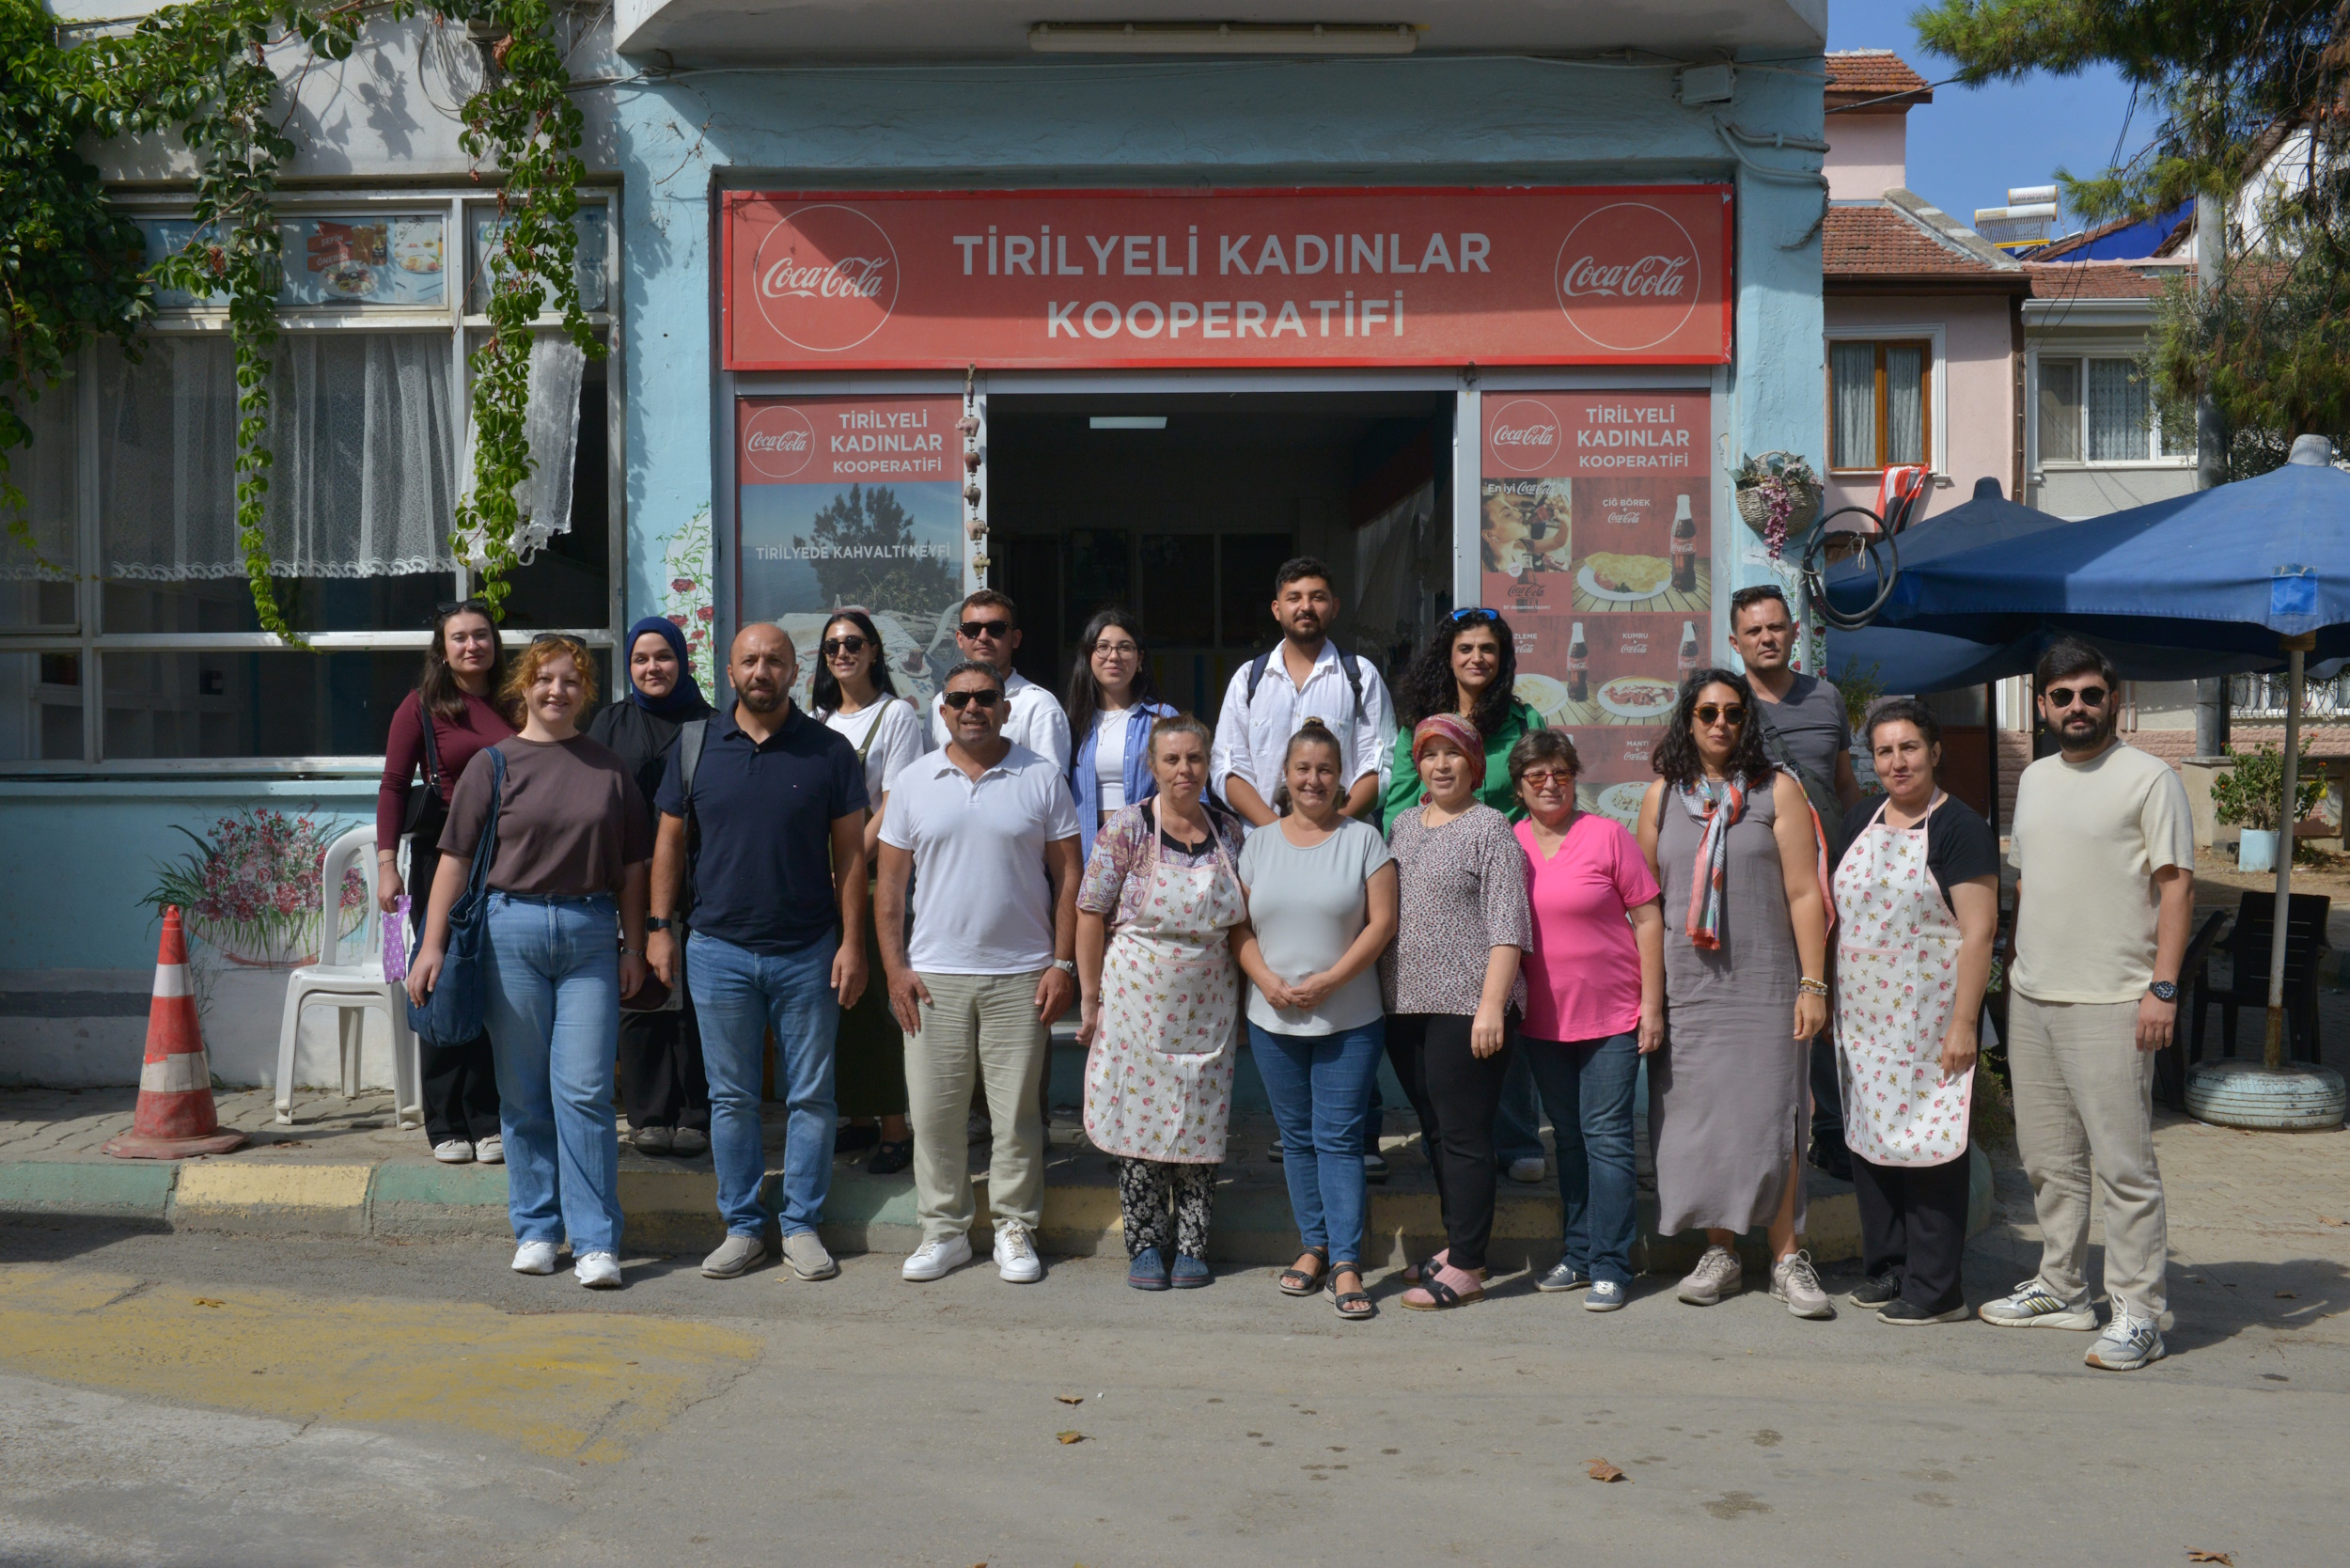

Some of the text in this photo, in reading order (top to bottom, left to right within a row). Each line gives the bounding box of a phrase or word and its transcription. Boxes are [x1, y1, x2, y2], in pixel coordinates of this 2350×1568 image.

[953, 225, 1490, 275] TİRİLYELİ KADINLAR
[761, 257, 889, 298] Coca-Cola
[1563, 255, 1691, 297] Coca-Cola
[1048, 290, 1403, 339] KOOPERATİFİ
[838, 409, 928, 429] TİRİLYELİ
[1585, 404, 1675, 424] TİRİLYELİ
[748, 431, 809, 452] Coca-Cola
[831, 434, 942, 453] KADINLAR
[1494, 424, 1556, 446] Coca-Cola
[1577, 430, 1689, 447] KADINLAR
[833, 457, 942, 473] KOOPERATİFİ
[1579, 452, 1688, 468] KOOPERATİFİ
[1488, 483, 1501, 493] En
[1504, 483, 1515, 494] iyi
[1602, 497, 1651, 508] ÇİĞ BÖREK
[1607, 512, 1641, 524] Coca-Cola
[756, 541, 950, 560] TİRİLYEDE KAHVALTI KEYFİ
[1508, 584, 1546, 597] Coca-Cola
[1621, 644, 1649, 653] Coca-Cola
[1623, 751, 1650, 760] Coca-Cola
